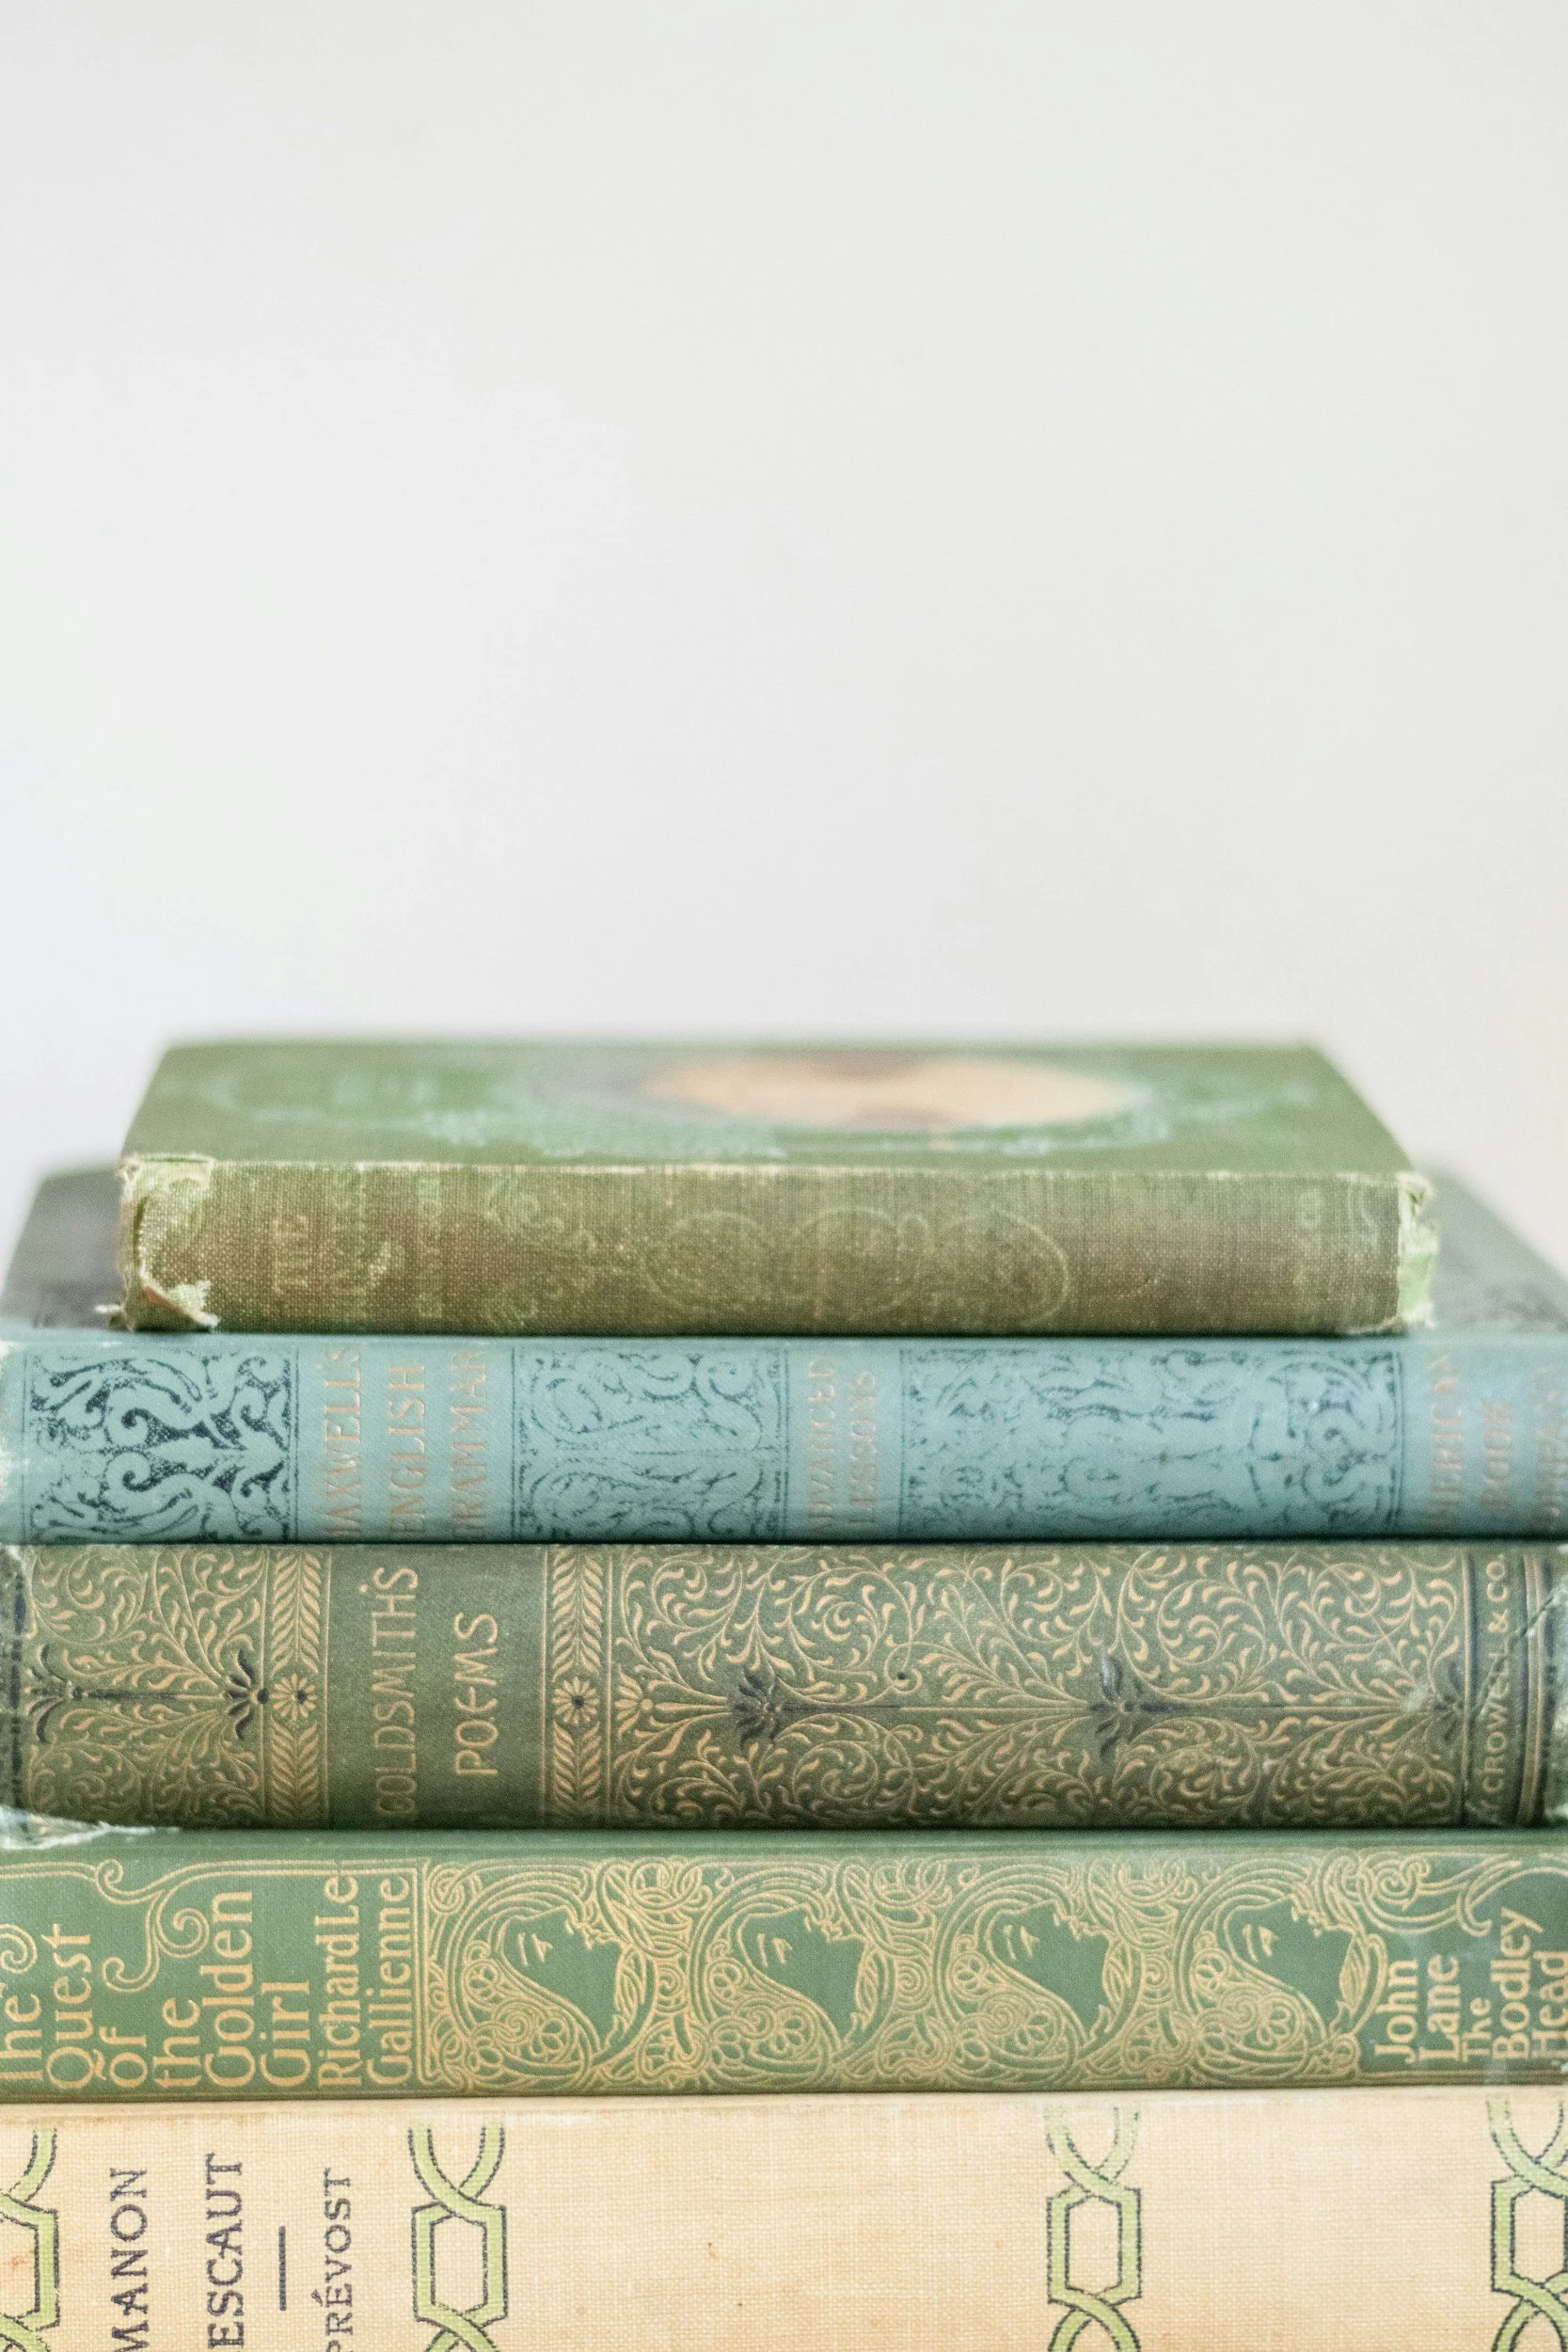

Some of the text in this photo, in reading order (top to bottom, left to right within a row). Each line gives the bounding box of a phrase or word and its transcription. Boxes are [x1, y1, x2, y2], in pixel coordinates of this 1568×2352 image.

[388, 1364, 427, 1536] ENGLISH
[358, 1567, 419, 1815] GOLDSMITH'S
[453, 1613, 499, 1775] POEMS
[1487, 1608, 1510, 1634] &
[41, 1923, 103, 2088] Quest
[100, 2026, 148, 2088] of
[152, 1997, 201, 2088] the
[199, 1890, 256, 2088] Golden
[260, 1980, 310, 2088] Girl
[314, 1876, 363, 2088] Richard Le
[366, 1877, 413, 2086] Gallienne
[1374, 1959, 1418, 2064] John
[1418, 1954, 1461, 2060] Lane
[1461, 1997, 1492, 2063] The
[1491, 1907, 1544, 2060] Bodley
[1530, 1950, 1568, 2059] Head
[110, 2168, 149, 2352] MANON
[206, 2153, 245, 2352] ESCAUT
